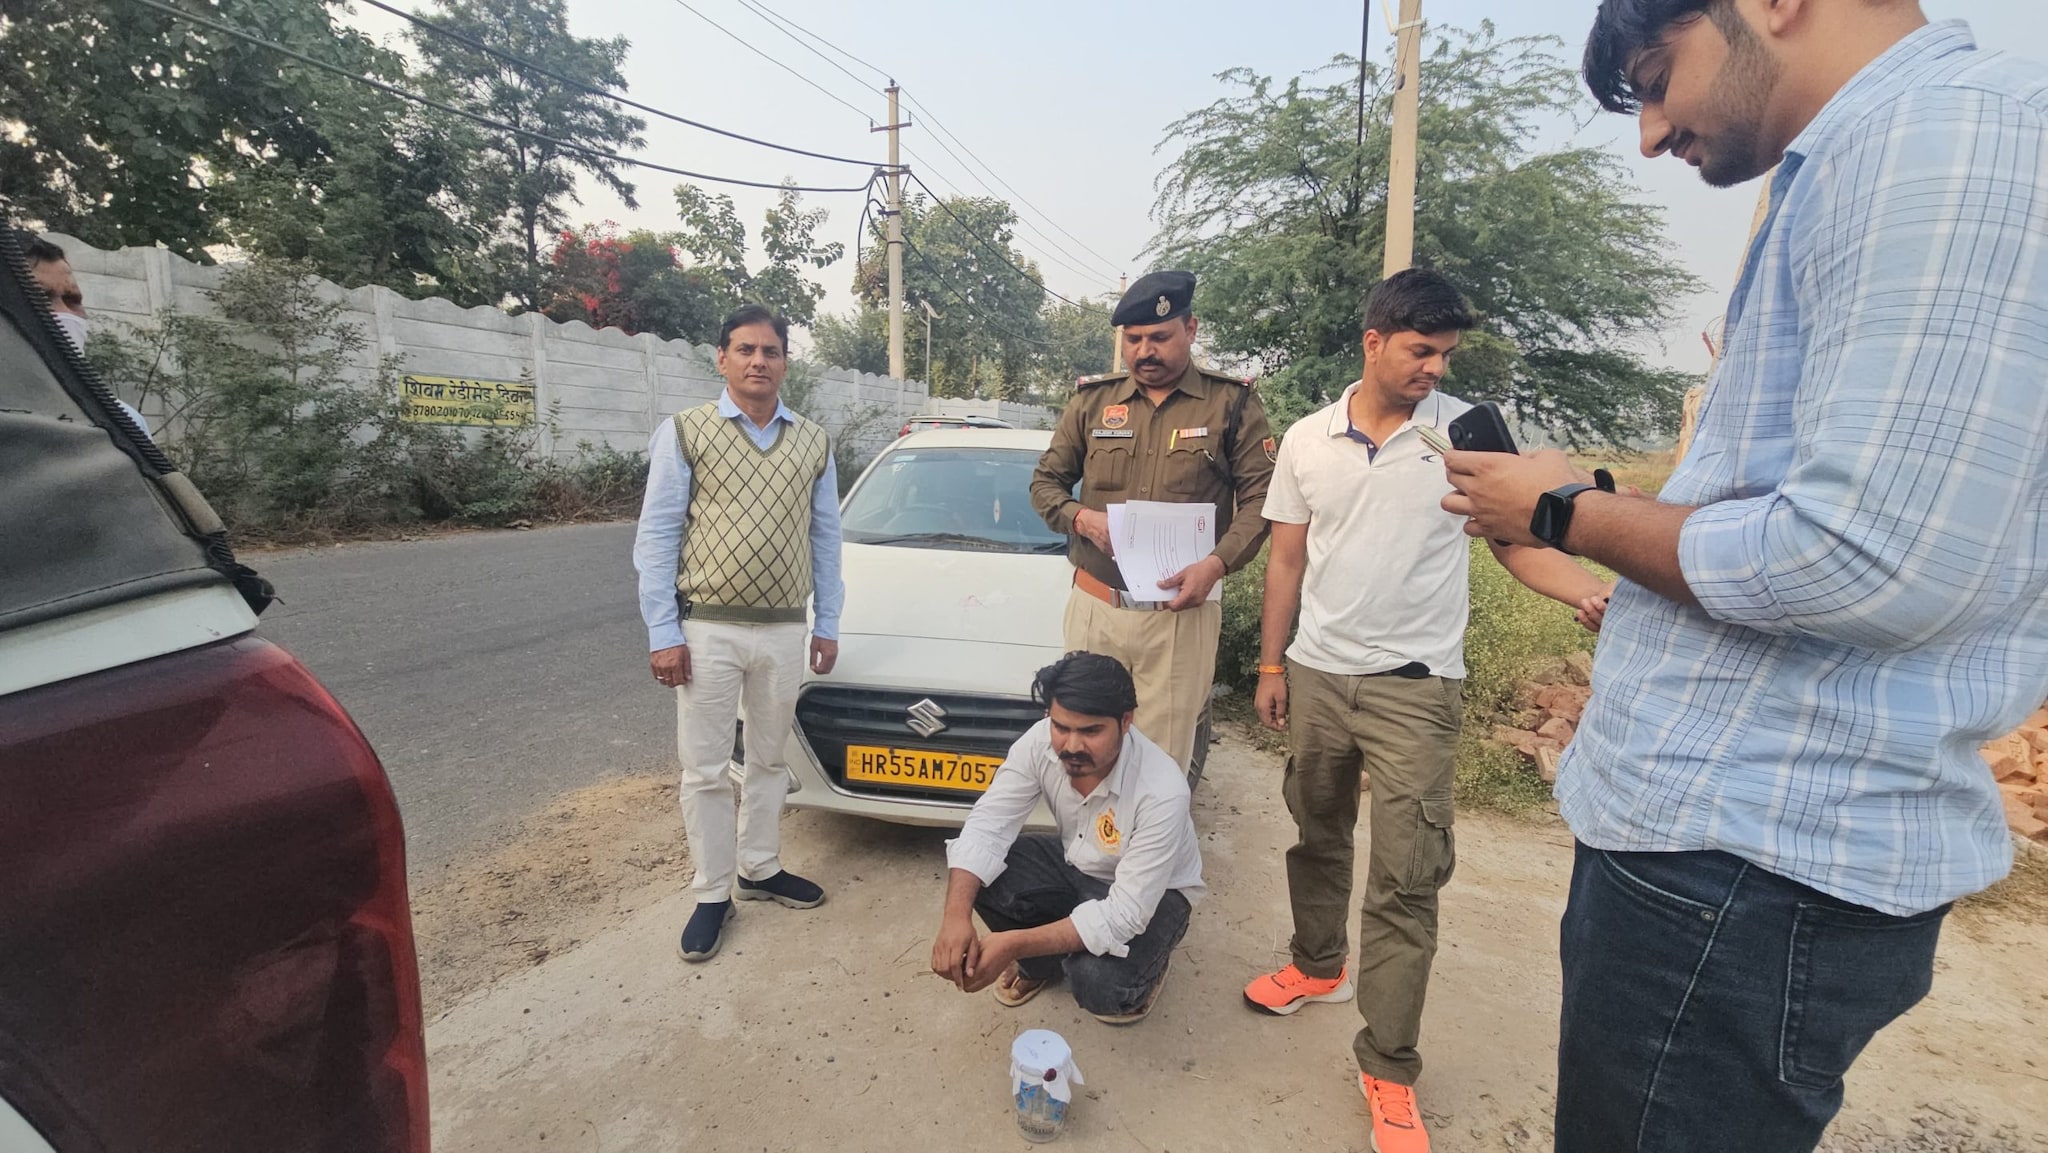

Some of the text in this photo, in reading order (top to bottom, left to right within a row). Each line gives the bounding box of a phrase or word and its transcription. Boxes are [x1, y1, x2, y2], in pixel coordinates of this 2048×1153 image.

[403, 376, 530, 404] शिवम रेडीमेड दिवा
[861, 753, 1000, 785] HR55AM7057
